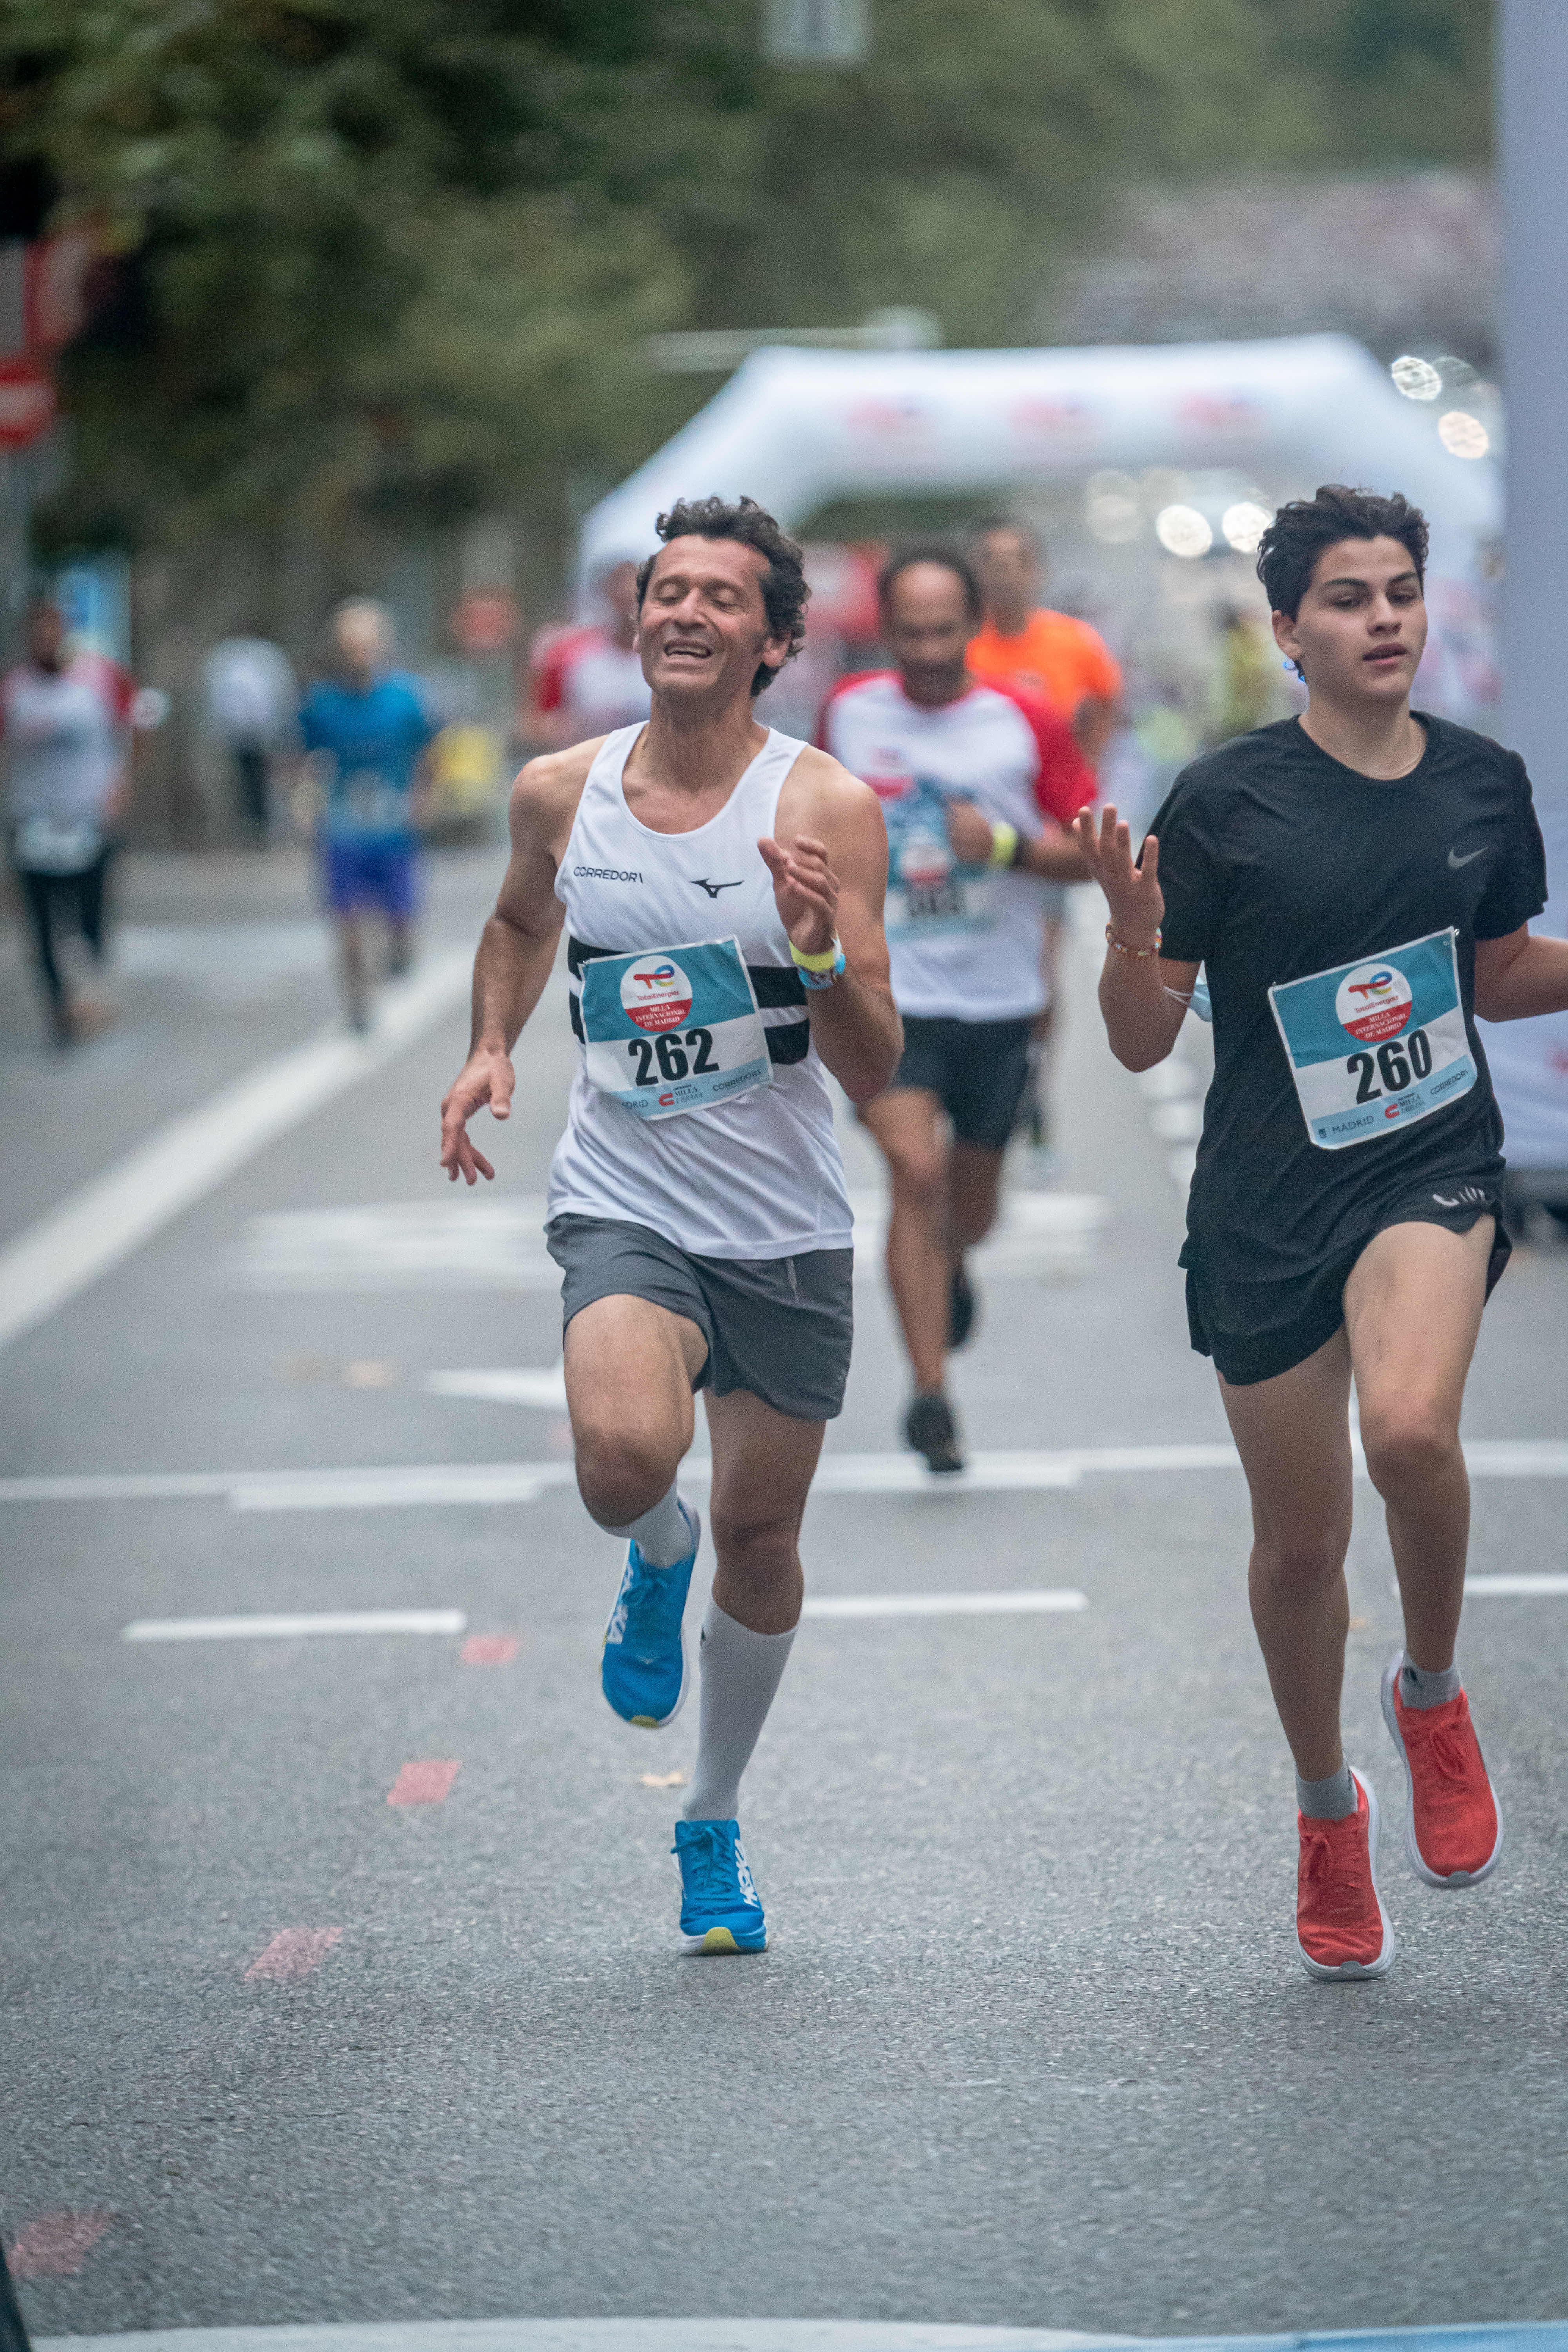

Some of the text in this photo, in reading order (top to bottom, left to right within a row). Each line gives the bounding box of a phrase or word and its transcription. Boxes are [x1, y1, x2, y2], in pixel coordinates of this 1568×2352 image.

[1354, 996, 1399, 1013] TotalEnergies
[654, 1016, 680, 1025] MADRID
[1368, 1012, 1390, 1023] MILLA
[1376, 1022, 1402, 1035] MADRID
[628, 1028, 719, 1087] 262
[1347, 1029, 1433, 1105] 260
[1332, 1115, 1374, 1134] MADRID
